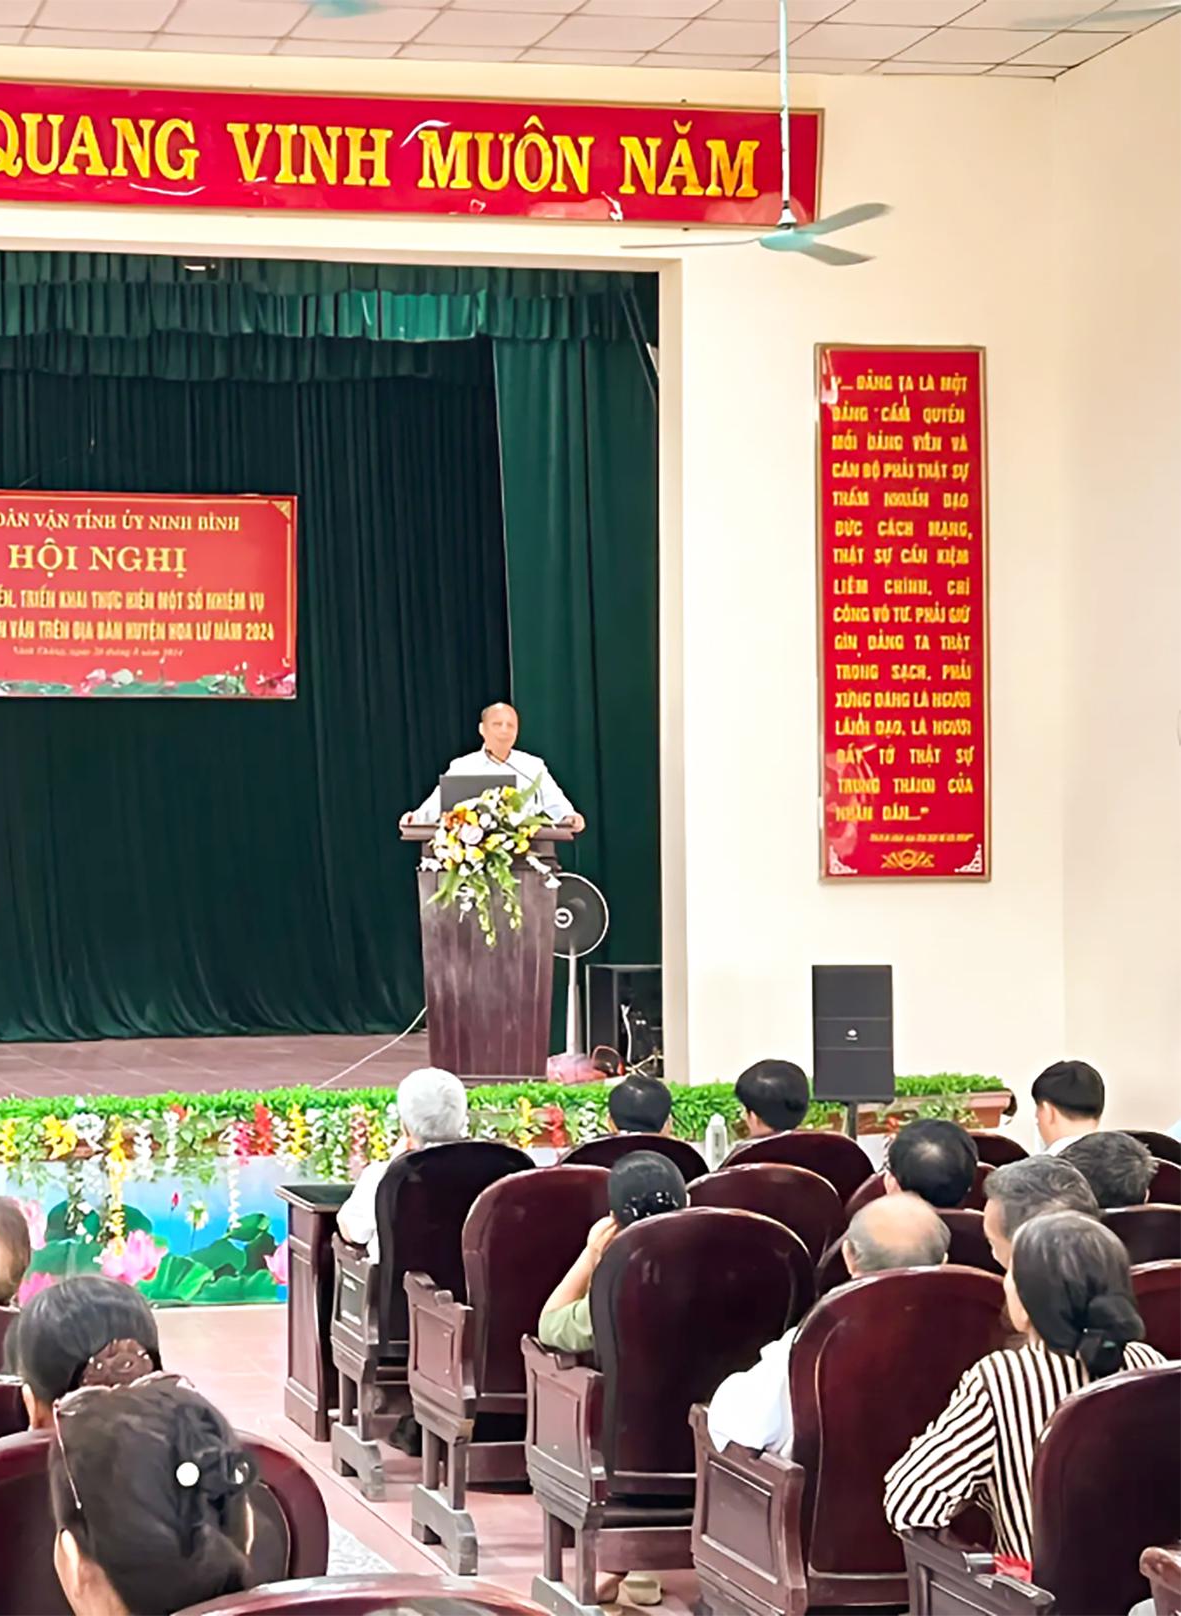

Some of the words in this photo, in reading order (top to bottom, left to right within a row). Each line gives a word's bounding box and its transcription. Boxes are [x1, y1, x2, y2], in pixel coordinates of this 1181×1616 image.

[226, 122, 394, 187] VINH
[417, 114, 595, 194] MUÔN
[618, 118, 761, 198] NĂM
[898, 375, 914, 392] TA
[918, 374, 935, 391] LÀ
[940, 372, 968, 396] MỘT
[867, 429, 904, 451] ĐẢNG
[912, 431, 942, 451] VIÊN
[883, 457, 915, 479] PHẢI
[33, 508, 70, 531] VẬN
[148, 515, 193, 531] NINH
[197, 512, 240, 532] BÌNH
[877, 518, 914, 537] CÁCH
[8, 537, 79, 578] HỘI
[88, 546, 187, 579] NGHỊ
[833, 603, 870, 622] CÔNG
[245, 622, 275, 641] 2024
[914, 634, 931, 650] TA
